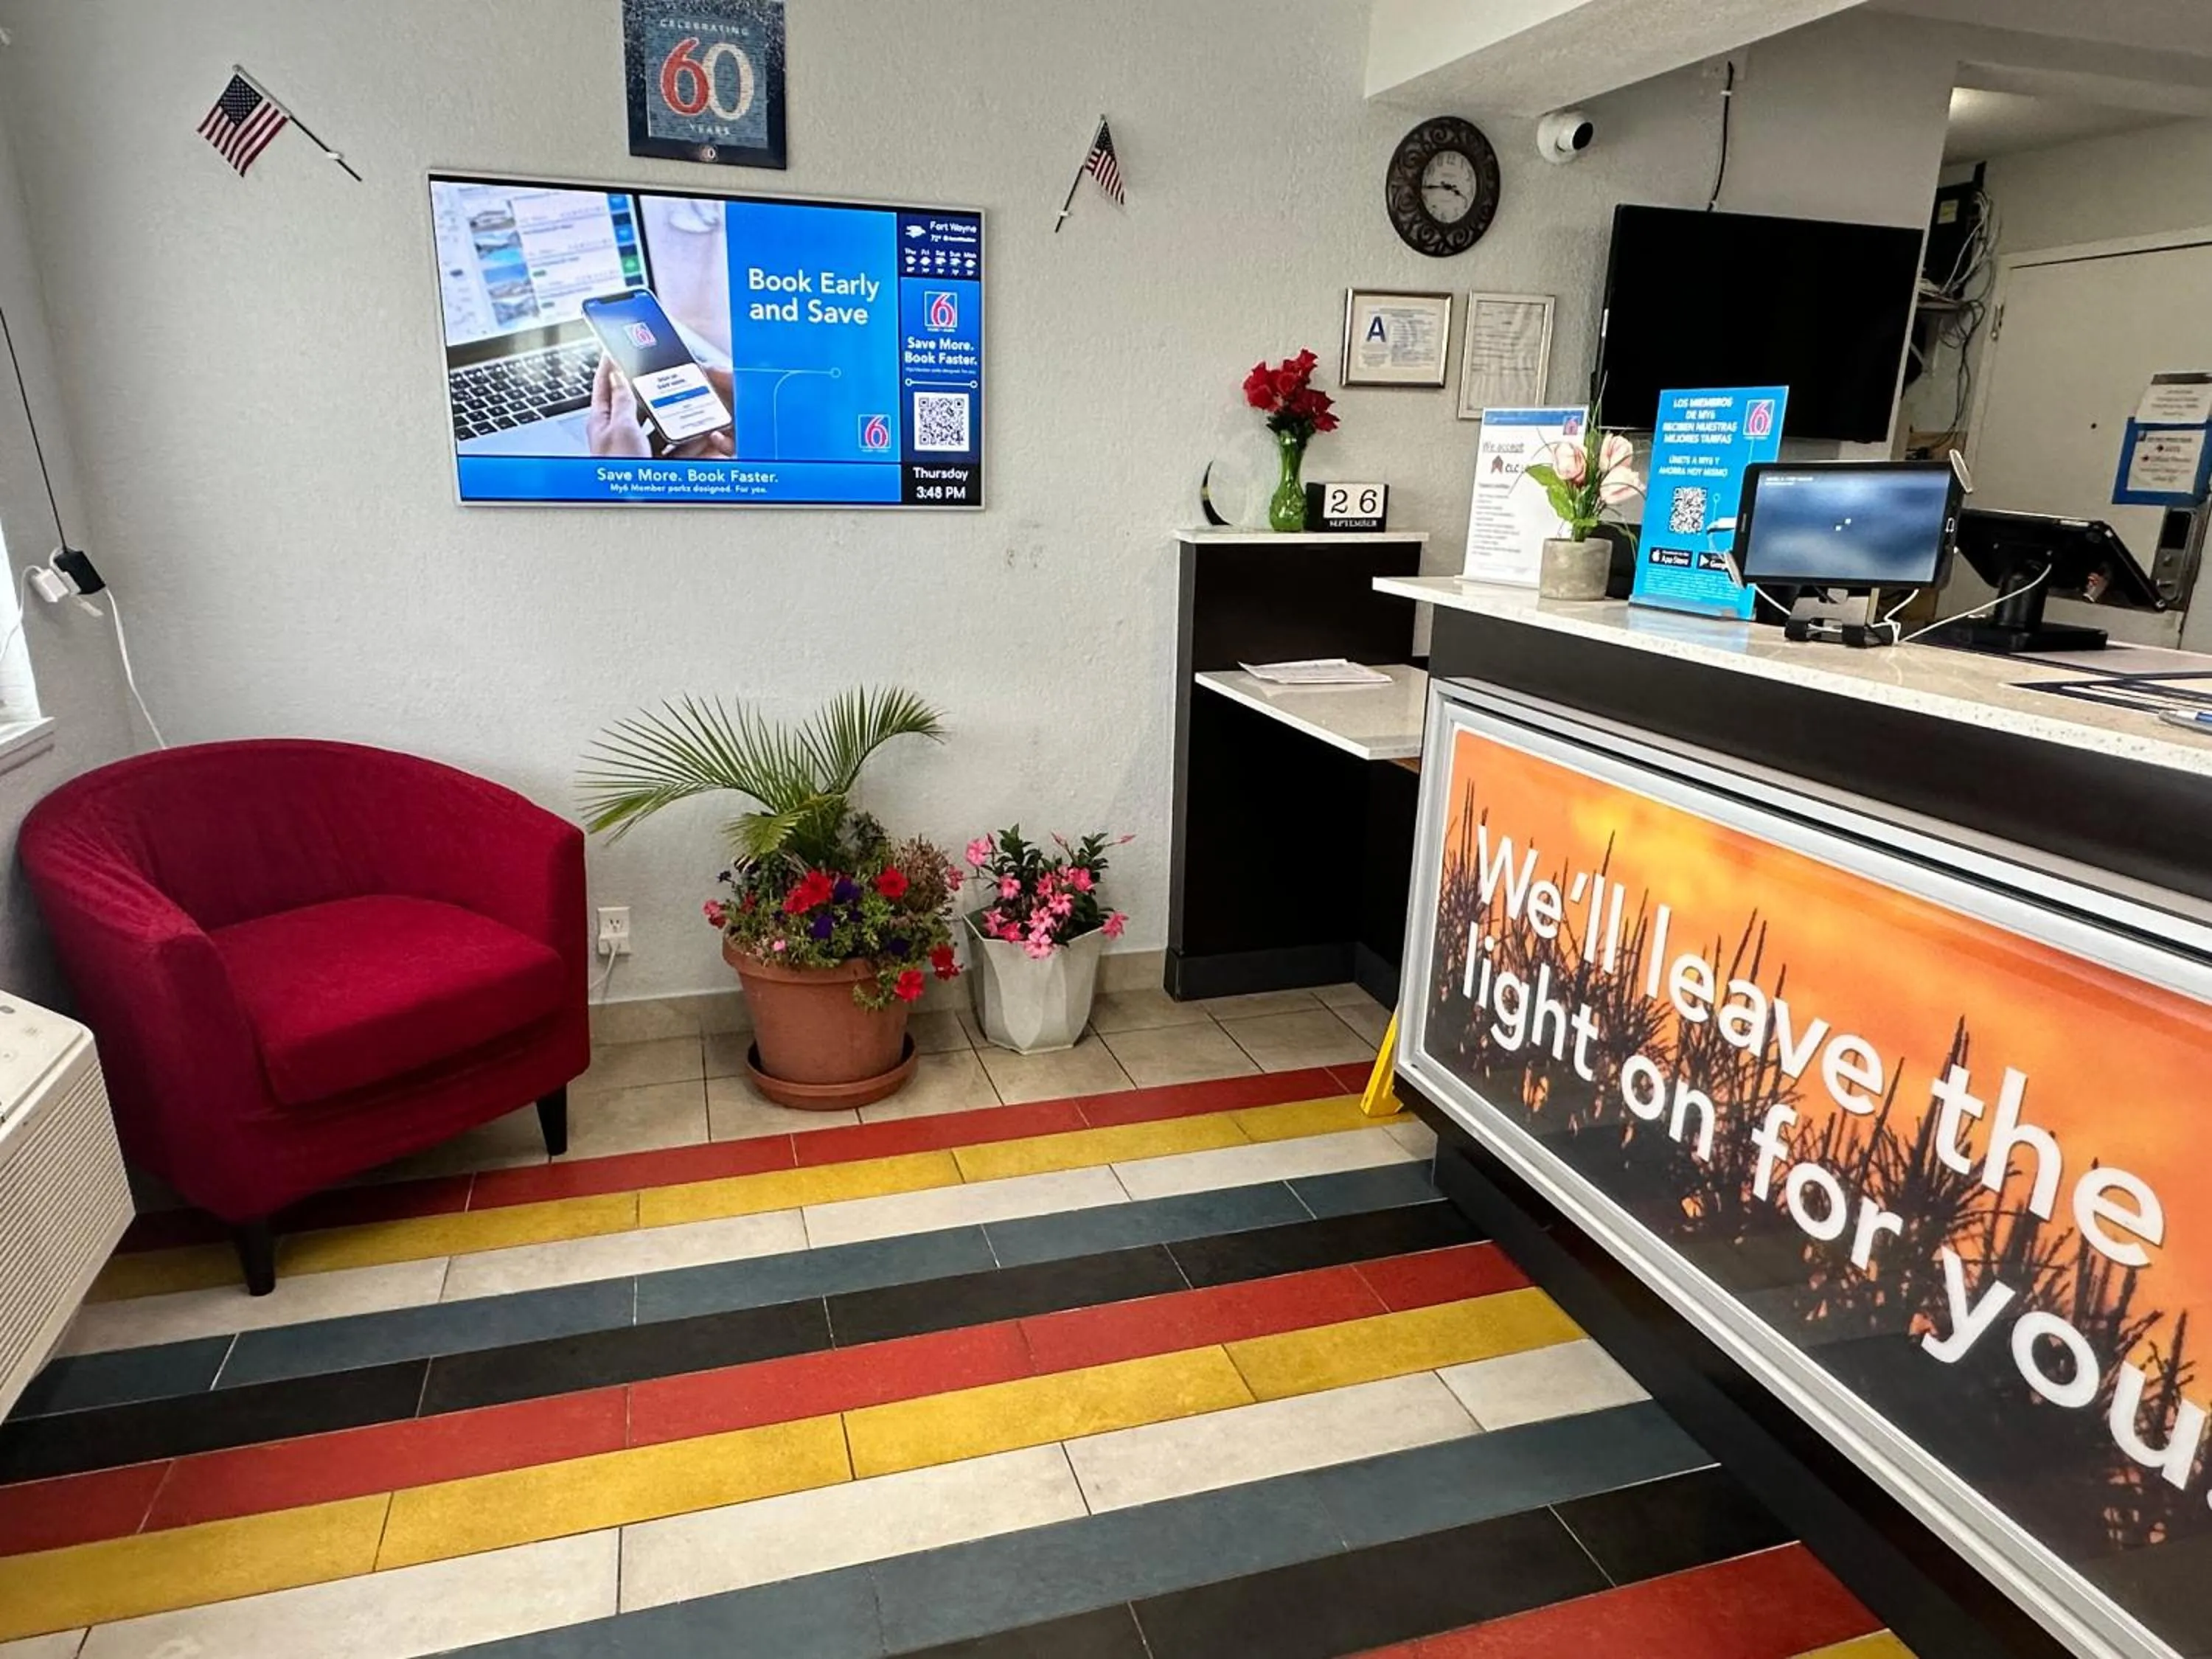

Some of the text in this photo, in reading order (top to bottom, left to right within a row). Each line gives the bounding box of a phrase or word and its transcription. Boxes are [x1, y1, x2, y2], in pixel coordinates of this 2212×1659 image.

[660, 18, 749, 36] CELEBRATING
[661, 37, 754, 120] 60
[689, 123, 731, 136] YEARS
[930, 220, 949, 232] Fort
[748, 268, 880, 302] Book Early
[749, 297, 869, 324] and Save
[931, 293, 956, 327] 6
[1366, 316, 1386, 342] A
[908, 336, 975, 351] Save More.
[904, 351, 978, 366] Book Faster.
[1748, 400, 1770, 434] 6
[864, 414, 889, 449] 6
[597, 467, 779, 483] Save More. Book Faster.
[912, 466, 969, 481] Thursday
[916, 486, 967, 499] 3:48 PM
[1329, 519, 1377, 527] SEPTEMBER
[1475, 824, 2163, 1267] We'll leave the
[1461, 922, 2212, 1512] light on for you
